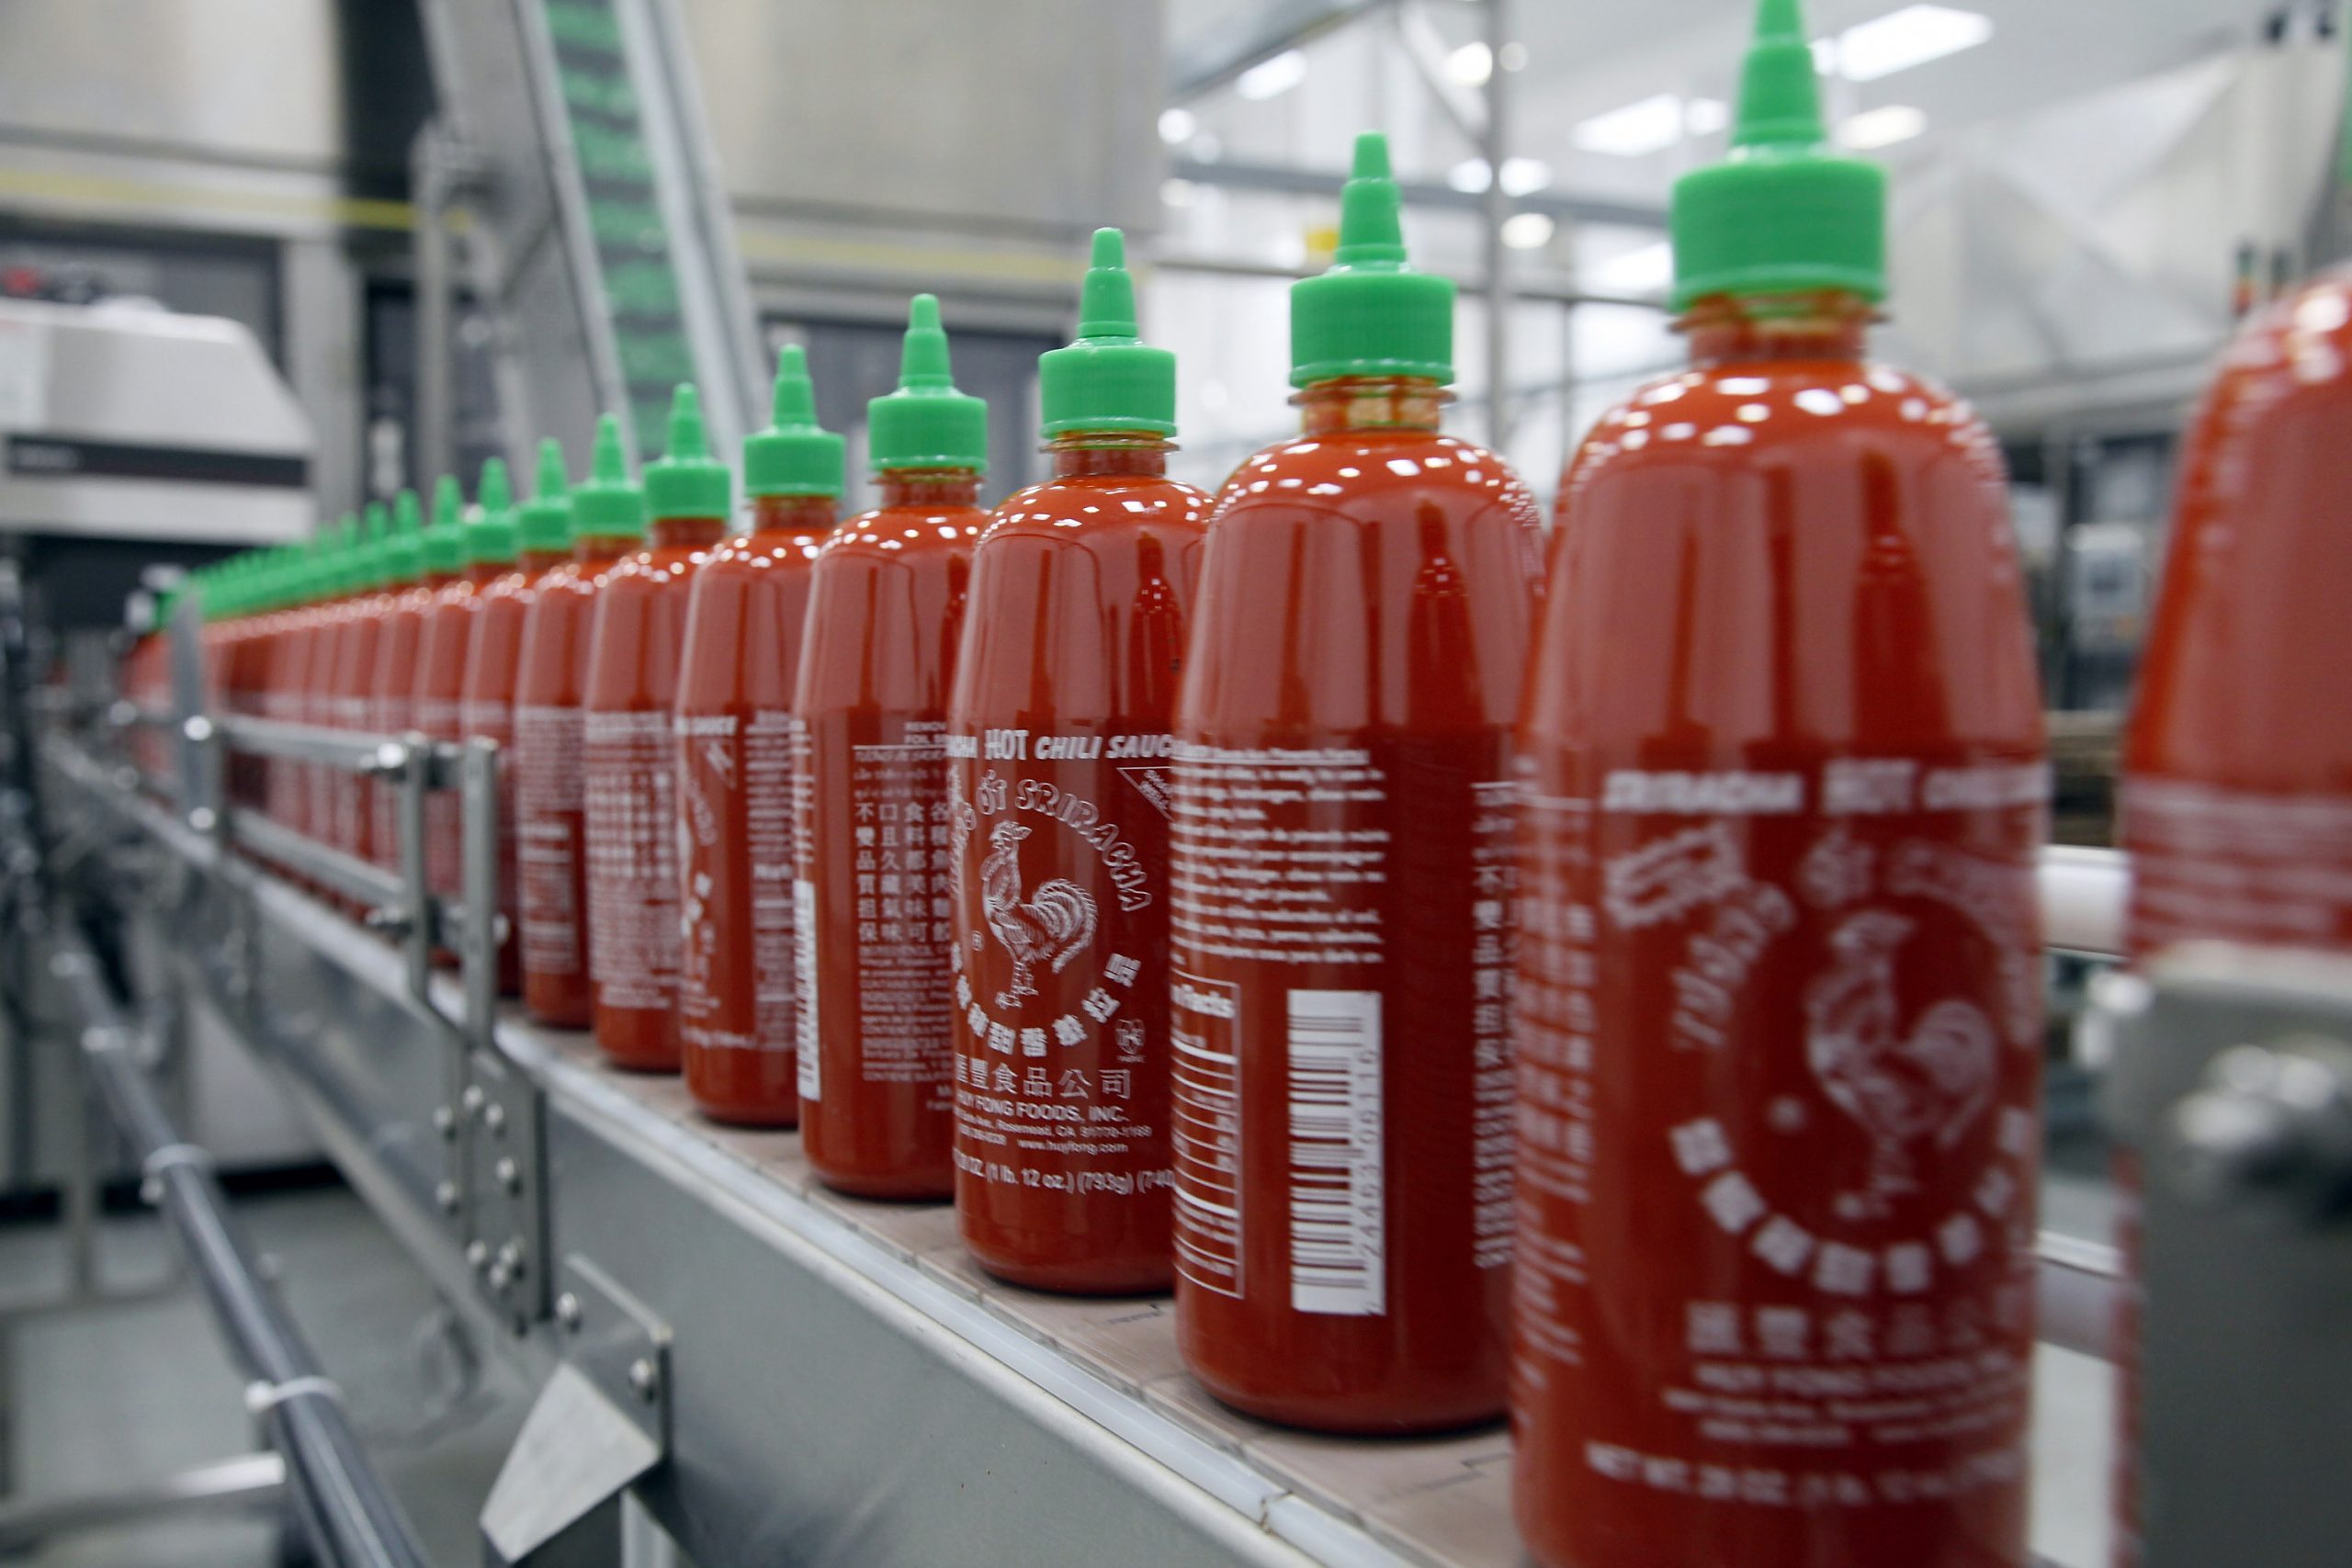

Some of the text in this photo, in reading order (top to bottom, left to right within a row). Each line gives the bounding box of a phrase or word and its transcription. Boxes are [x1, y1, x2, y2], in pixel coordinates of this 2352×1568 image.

[984, 728, 1029, 761] HOT
[1035, 736, 1102, 760] CHILI
[1105, 734, 1175, 759] SAUC
[974, 1094, 1014, 1117] FONG
